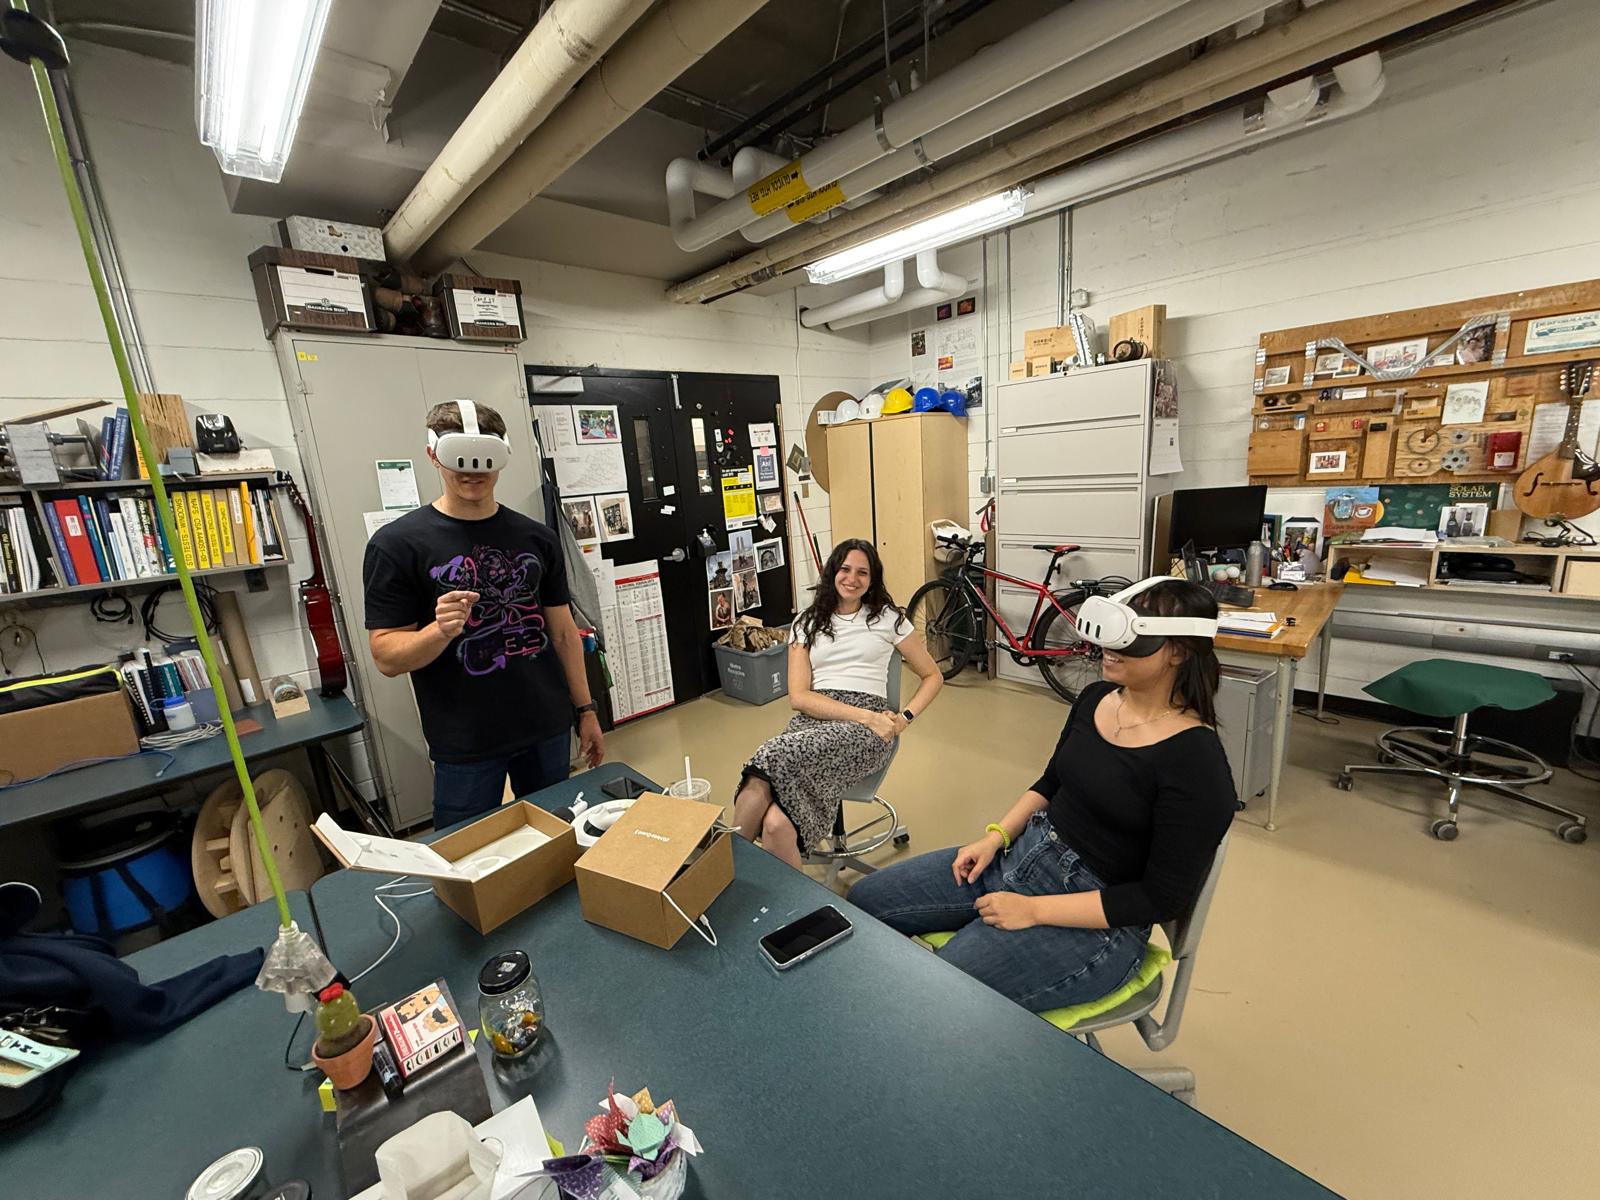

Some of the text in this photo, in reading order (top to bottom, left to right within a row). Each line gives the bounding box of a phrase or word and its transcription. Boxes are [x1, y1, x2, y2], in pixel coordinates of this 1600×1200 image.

[771, 174, 790, 191] GLYCOL
[175, 498, 186, 528] WINDOWS
[194, 518, 202, 531] CSA
[182, 534, 191, 554] TESTS
[185, 554, 194, 567] STD
